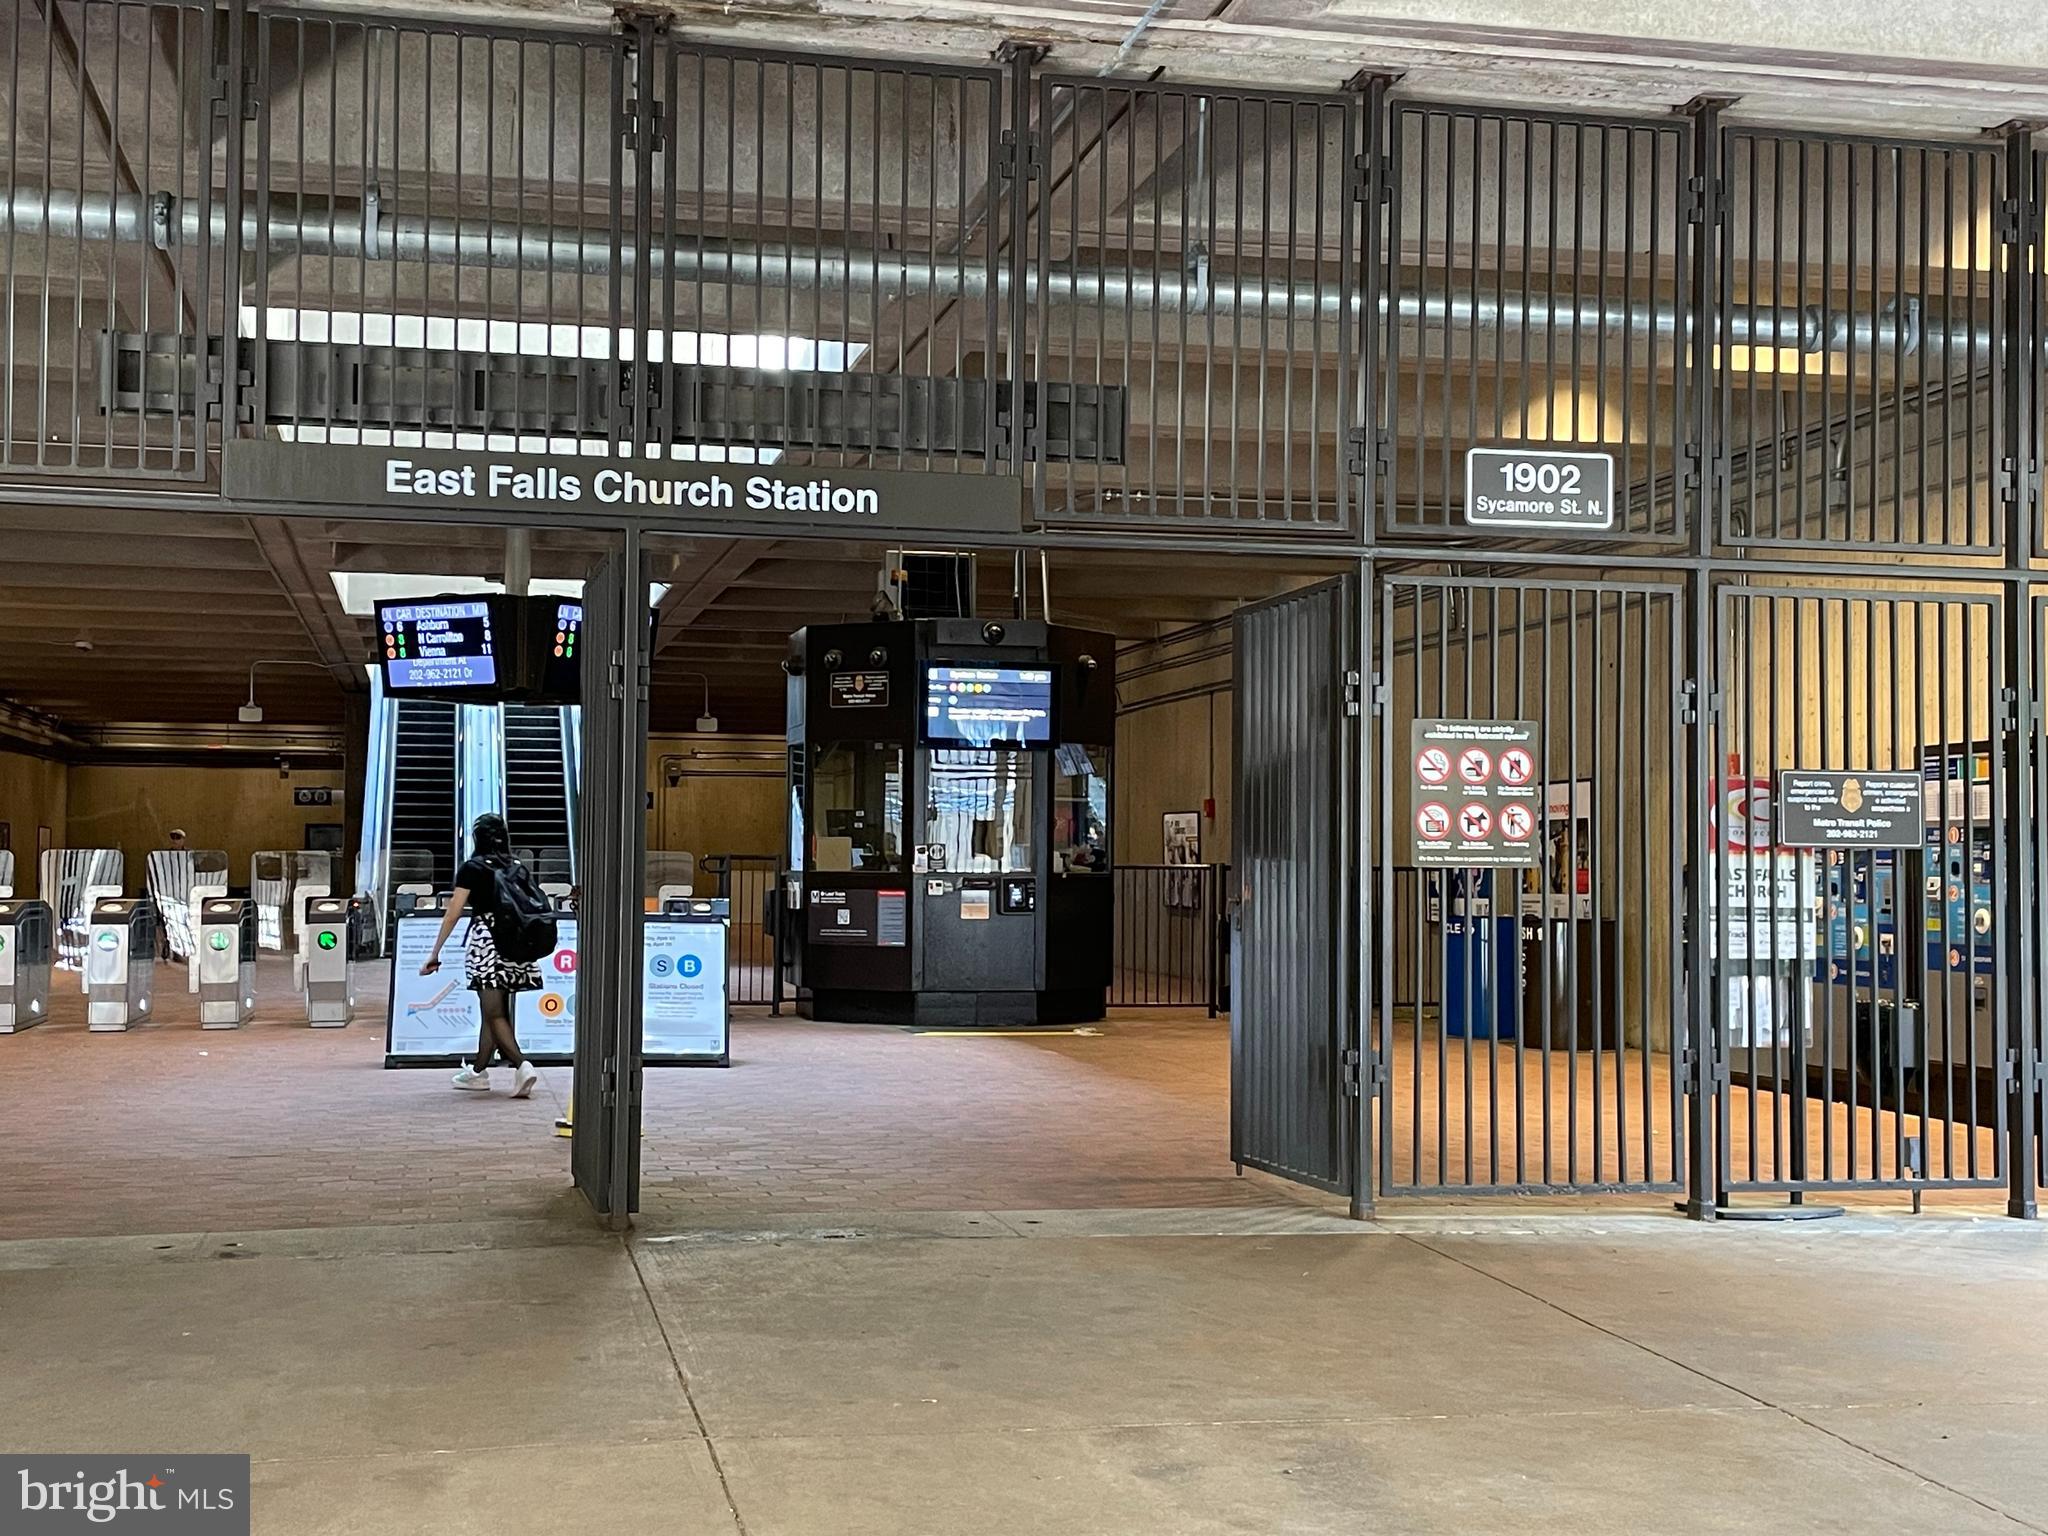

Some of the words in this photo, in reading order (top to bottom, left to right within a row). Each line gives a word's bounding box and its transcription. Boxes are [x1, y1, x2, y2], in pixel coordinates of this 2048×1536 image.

[1500, 462, 1581, 495] 1902
[386, 459, 476, 497] East
[488, 464, 581, 501] Falls
[593, 469, 733, 509] Church
[745, 479, 879, 515] Station
[1476, 495, 1554, 514] Sycamore
[1560, 498, 1583, 515] St.
[1587, 500, 1603, 516] N.
[396, 621, 404, 632] 6
[416, 620, 449, 631] Ashburn
[569, 620, 576, 631] 6
[418, 645, 446, 657] Vienna
[481, 643, 492, 655] 11
[1813, 818, 1836, 827] Metro
[1836, 818, 1865, 828] Transit
[1866, 818, 1891, 828] Police
[560, 954, 573, 969] R
[657, 959, 667, 972] S
[684, 960, 696, 972] B
[545, 998, 558, 1012] O
